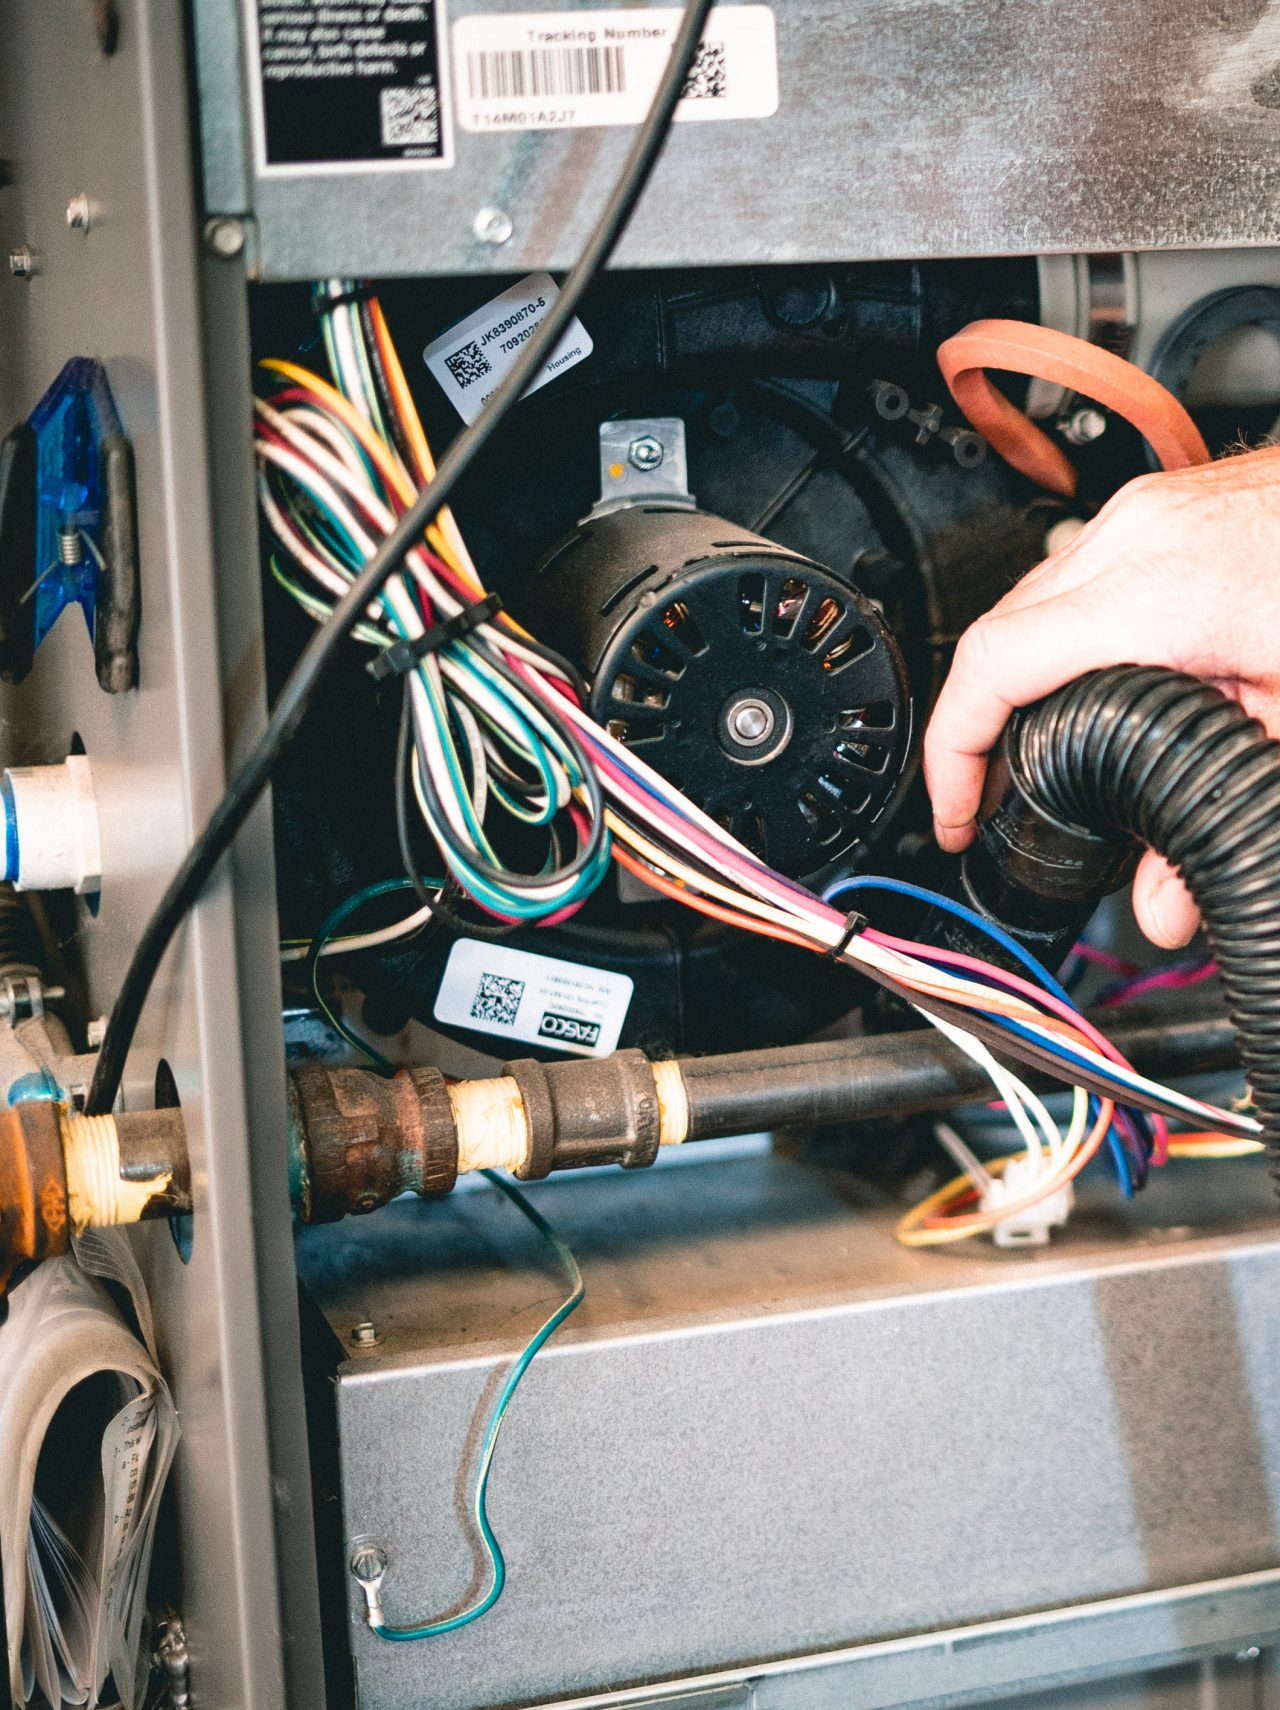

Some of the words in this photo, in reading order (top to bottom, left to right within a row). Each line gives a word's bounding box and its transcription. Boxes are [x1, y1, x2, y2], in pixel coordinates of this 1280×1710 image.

[309, 27, 340, 42] also
[342, 26, 387, 41] cause
[527, 28, 597, 43] Tracking
[604, 27, 667, 40] Number
[317, 43, 352, 59] birth
[354, 42, 408, 58] defects
[409, 42, 427, 56] or
[264, 62, 354, 80] reproductive
[356, 61, 398, 75] harm.
[480, 296, 546, 346] JK8390870-5
[546, 346, 582, 372] Housing
[541, 1015, 600, 1042] FASCO
